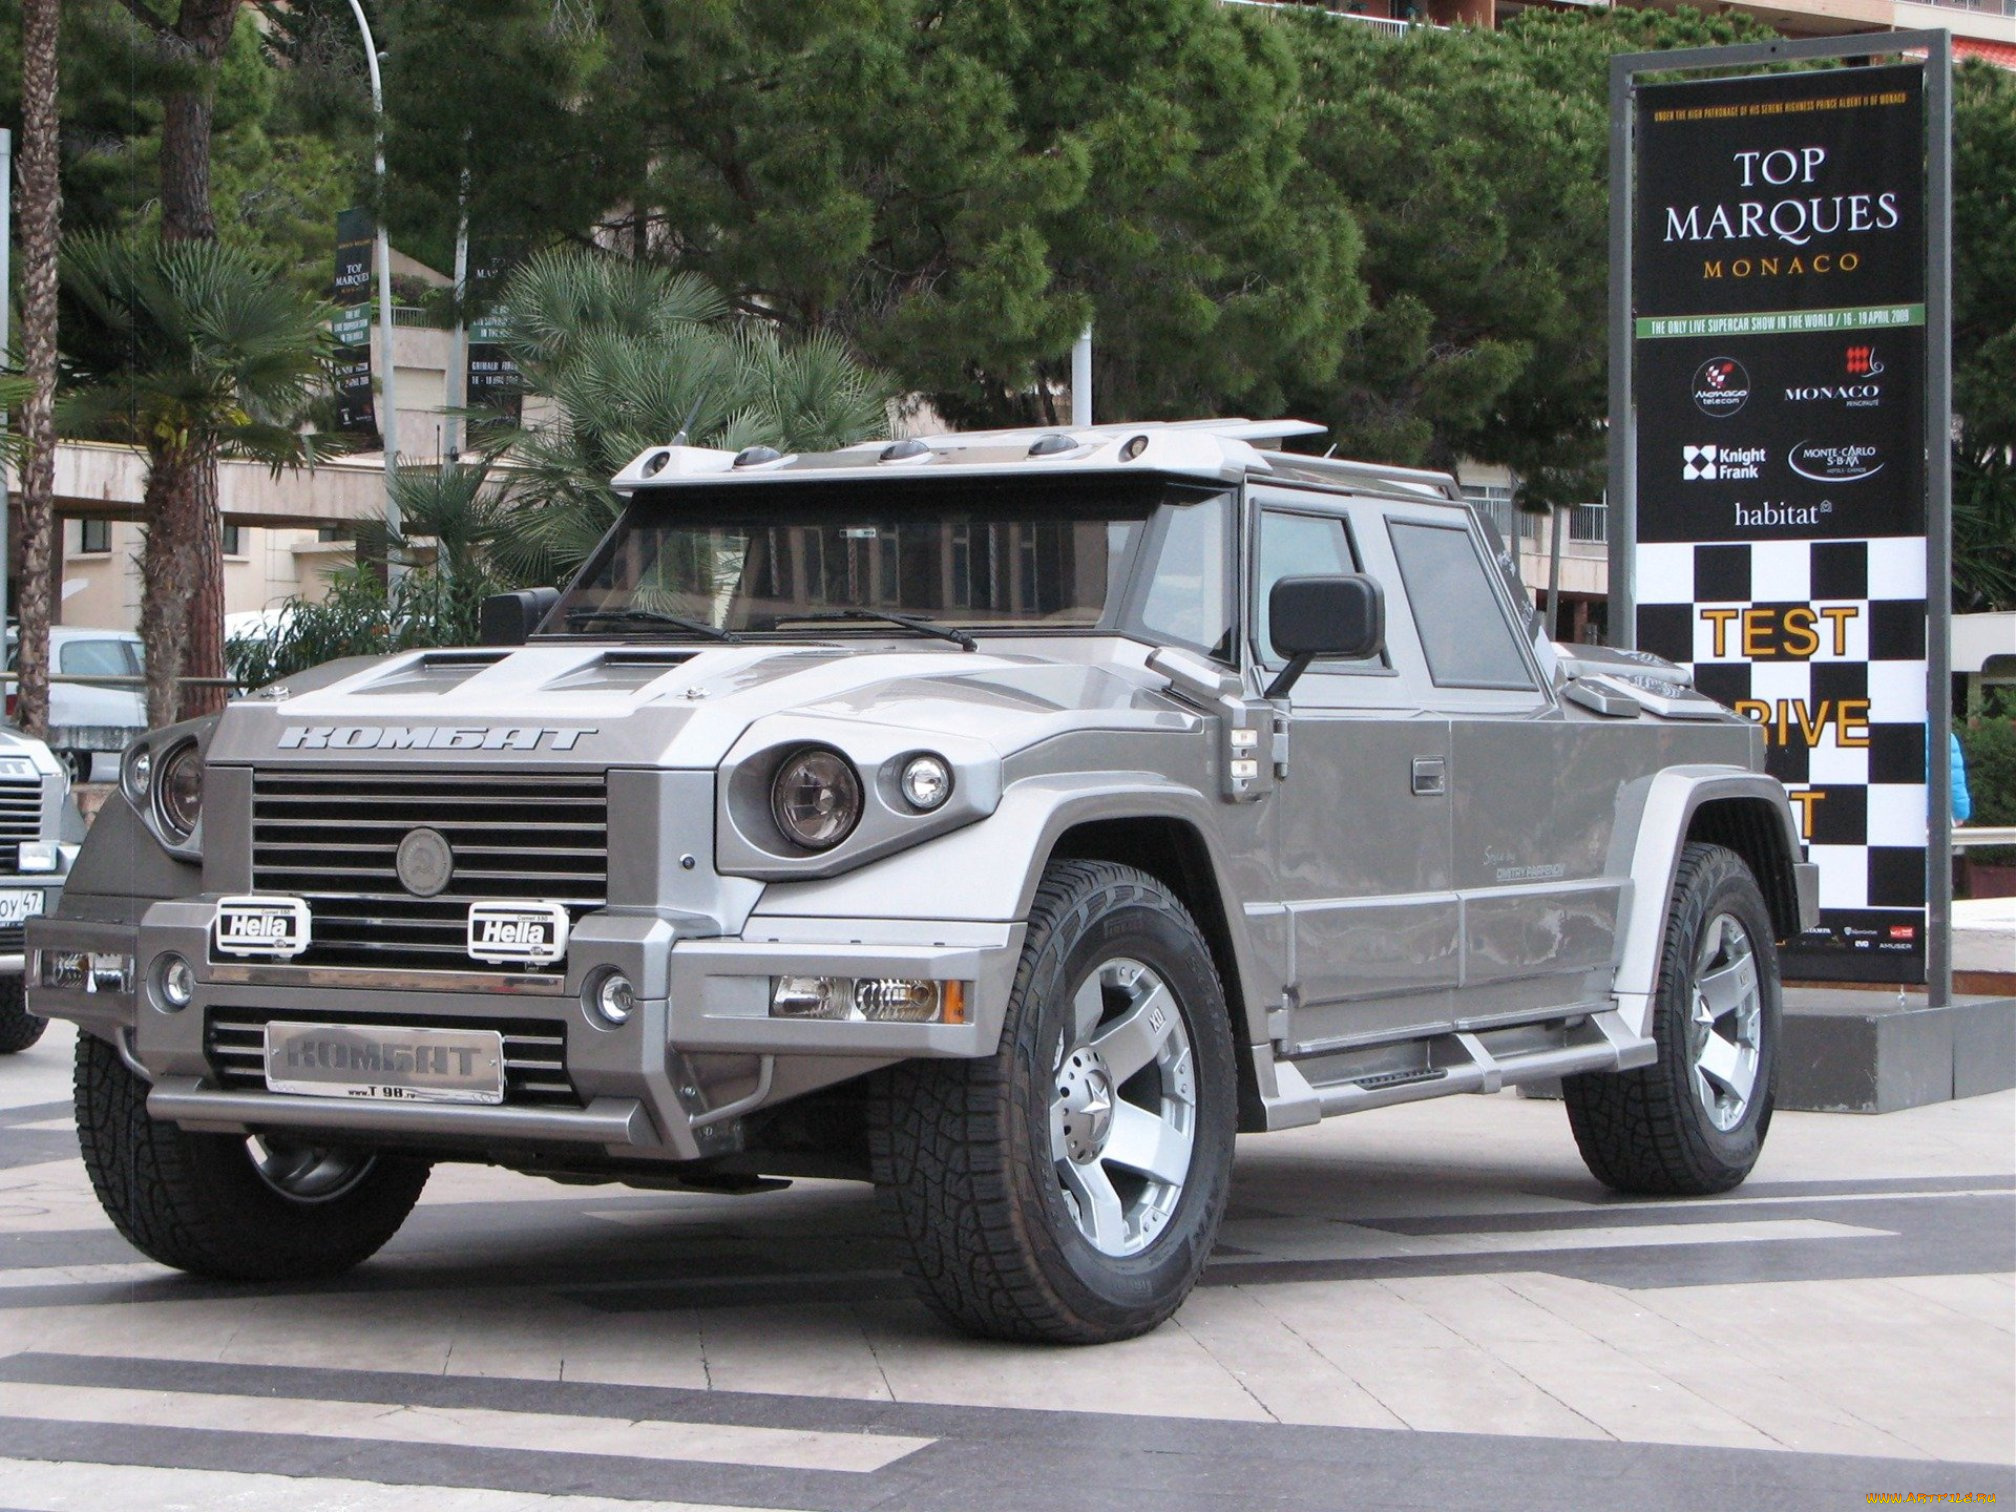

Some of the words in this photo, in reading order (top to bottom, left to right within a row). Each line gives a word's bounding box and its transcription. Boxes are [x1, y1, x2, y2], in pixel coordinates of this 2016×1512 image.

[1733, 147, 1825, 187] TOP
[1663, 192, 1898, 245] MARQUES
[1704, 253, 1858, 278] MONACO
[1651, 320, 1665, 334] THE
[1667, 320, 1687, 334] ONLY
[1689, 319, 1705, 333] LIVE
[1708, 317, 1749, 333] SUPERCAR
[1751, 316, 1776, 331] SHOW
[1777, 315, 1786, 329] IN
[1788, 314, 1802, 328] THE
[1804, 313, 1834, 328] WORLD
[1843, 312, 1852, 326] 16
[1858, 311, 1867, 325] 19
[1868, 310, 1890, 324] APRIL
[1784, 385, 1879, 400] MONACO
[1719, 448, 1766, 464] Knight
[1719, 465, 1758, 479] Frank
[1734, 501, 1819, 526] habitat
[1701, 606, 1858, 658] TEST
[1734, 698, 1870, 748] RIVE
[277, 727, 599, 750] КОМБАТ
[230, 915, 287, 936] Hella
[482, 921, 545, 944] Hella
[286, 1037, 481, 1076] КОМБАТ
